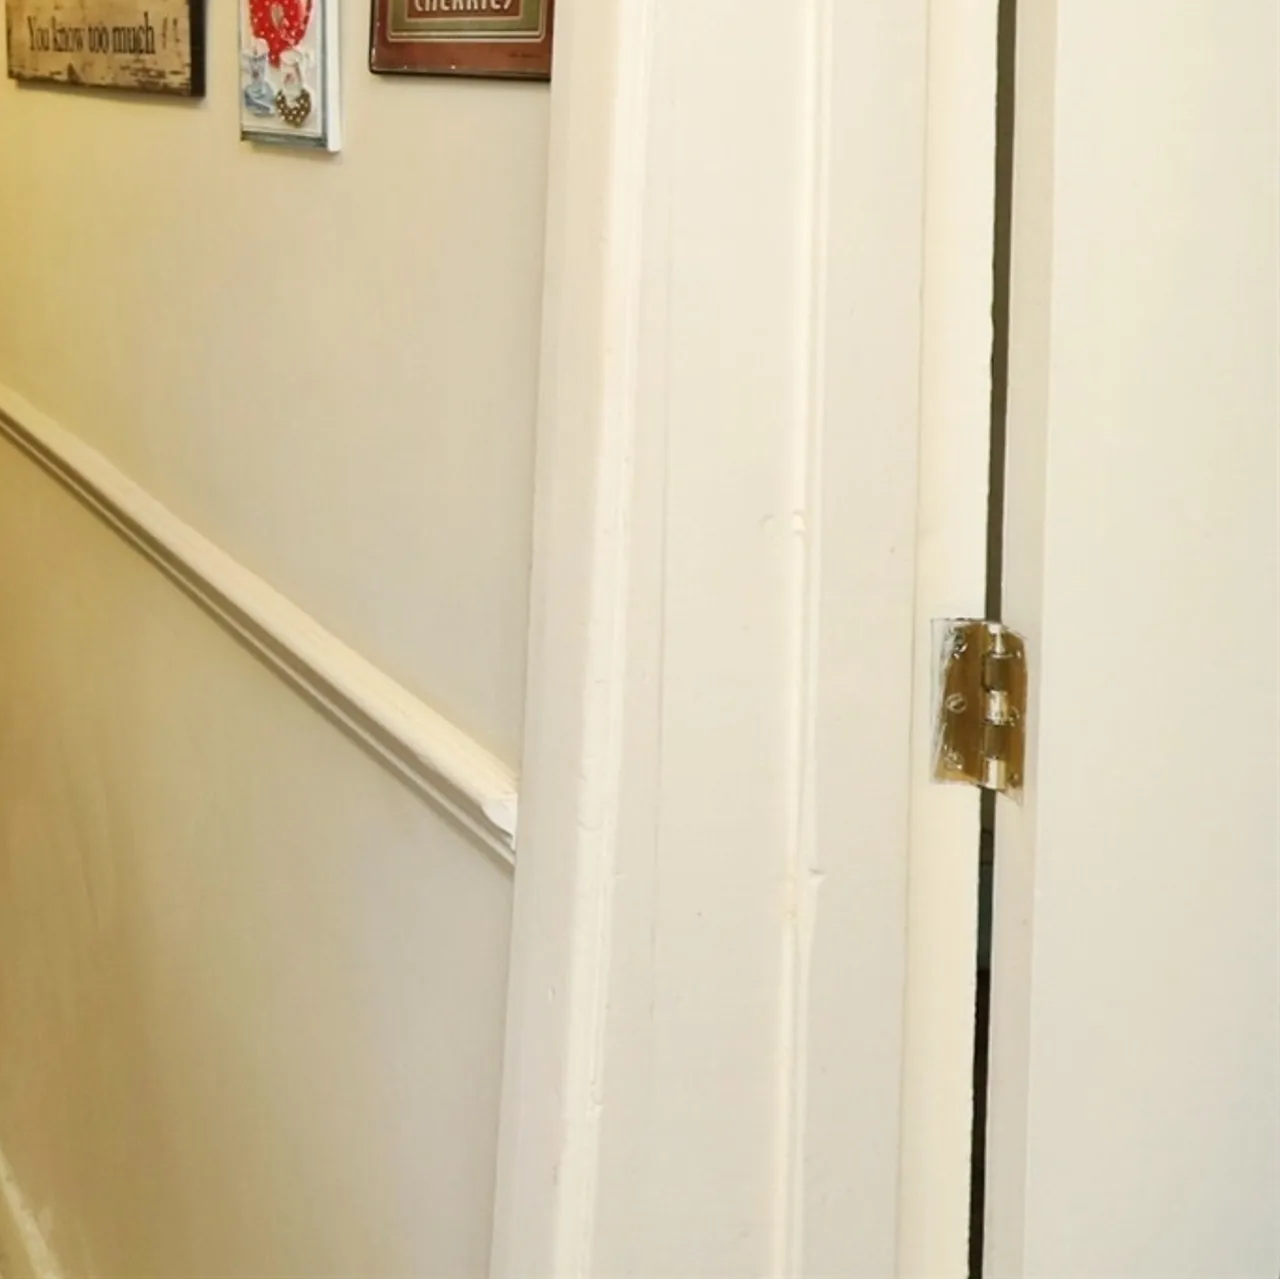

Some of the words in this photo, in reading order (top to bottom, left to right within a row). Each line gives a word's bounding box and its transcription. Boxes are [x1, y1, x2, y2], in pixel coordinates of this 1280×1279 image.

[27, 16, 49, 52] You
[51, 16, 85, 53] know
[87, 23, 110, 55] too
[112, 11, 156, 55] much
